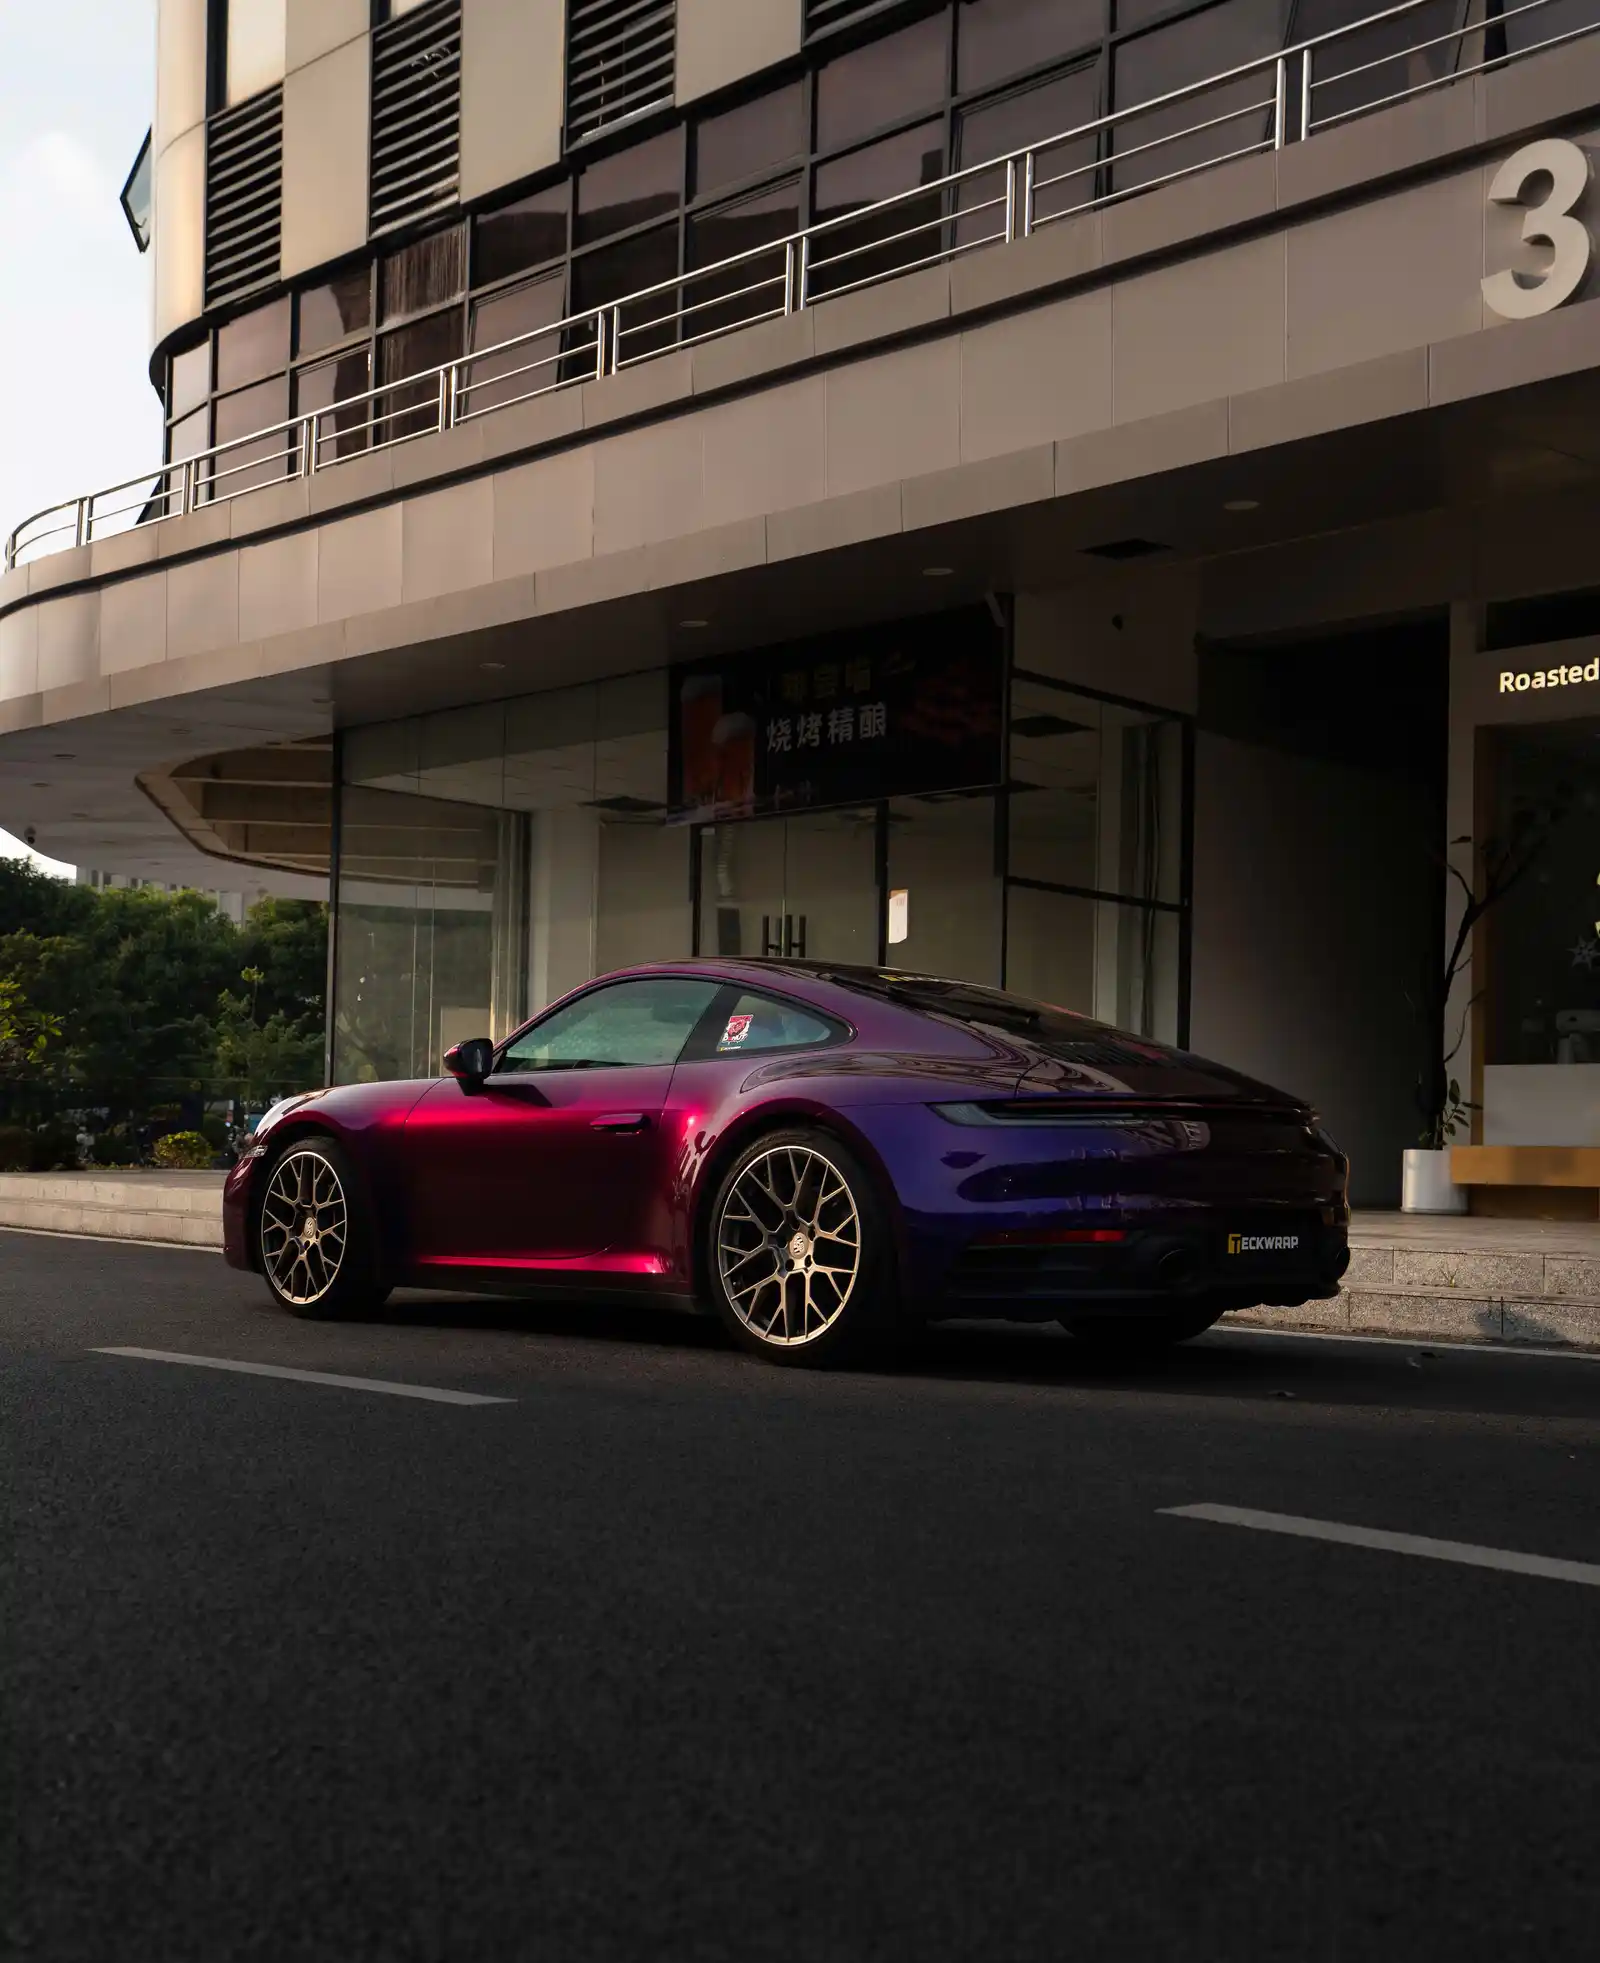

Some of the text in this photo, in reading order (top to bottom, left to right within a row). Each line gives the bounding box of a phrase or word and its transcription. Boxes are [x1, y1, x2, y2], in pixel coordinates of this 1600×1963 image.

[1481, 138, 1590, 319] 3
[1500, 657, 1600, 693] Roasted
[767, 701, 887, 753] 烧烤精酿
[1228, 1233, 1299, 1254] TECKWRAP
